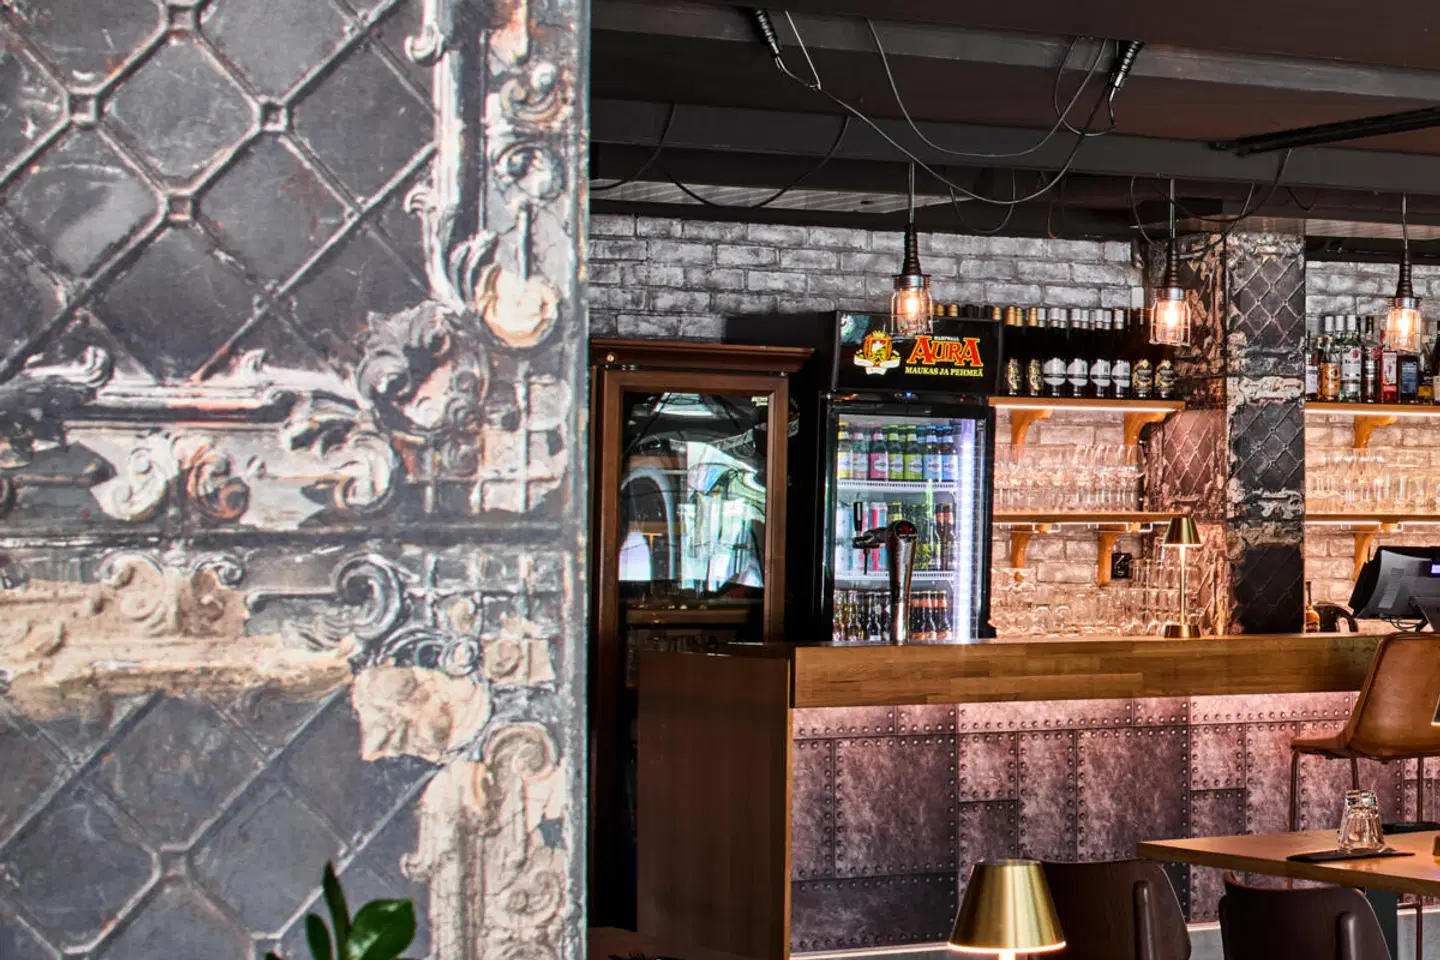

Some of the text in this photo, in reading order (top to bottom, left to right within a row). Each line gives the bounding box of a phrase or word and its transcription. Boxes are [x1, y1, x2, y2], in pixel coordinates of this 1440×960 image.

[906, 335, 984, 366] AURA
[905, 366, 939, 376] MAUKAS
[939, 367, 949, 376] JA
[950, 367, 984, 377] PEHMEÄ
